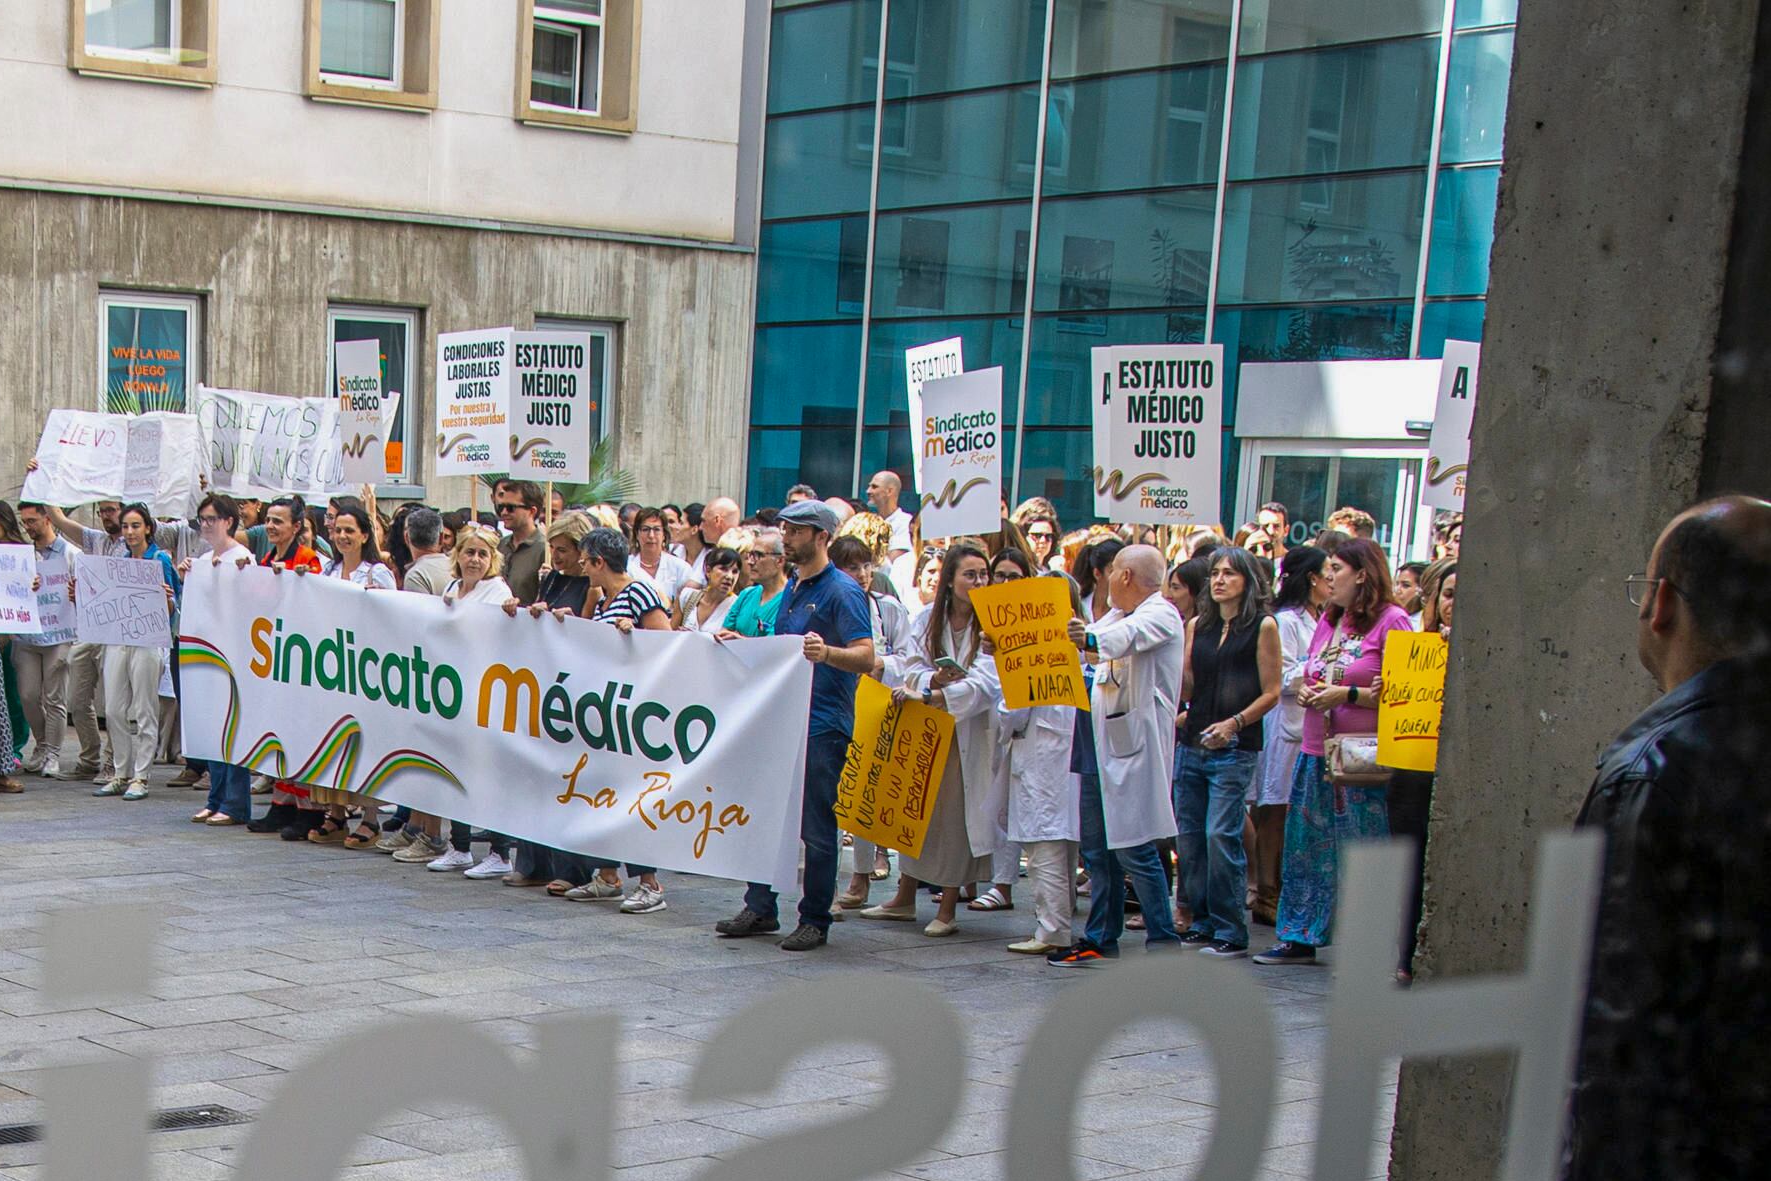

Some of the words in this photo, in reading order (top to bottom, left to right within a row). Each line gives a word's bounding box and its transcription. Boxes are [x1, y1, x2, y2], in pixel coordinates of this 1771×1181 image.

[112, 347, 136, 360] VIVE
[140, 348, 154, 360] LA
[155, 349, 180, 360] VIDA
[444, 340, 505, 362] CONDICIONES
[515, 344, 584, 369] ESTATUTO
[128, 365, 166, 378] LUEGO
[448, 360, 500, 381] LABORALES
[911, 352, 957, 384] ESTATUTO
[1118, 360, 1214, 388] ESTATUTO
[340, 375, 378, 392] Sindicato
[455, 381, 490, 400] JUSTAS
[521, 368, 577, 398] MÉDICO
[1450, 366, 1468, 400] A
[450, 404, 461, 415] Por
[463, 402, 490, 414] nuestra
[492, 402, 497, 414] y
[526, 402, 572, 427] JUSTO
[1127, 388, 1204, 424] MÉDICO
[198, 398, 317, 439] CUIDEMOS
[442, 416, 468, 428] vuestra
[470, 414, 506, 428] seguridad
[925, 410, 996, 435] Sindicato
[58, 423, 116, 448] LLEVO
[1134, 430, 1196, 458] JUSTO
[457, 443, 490, 453] Sindicato
[532, 449, 566, 459] Sindicato
[950, 453, 964, 467] La
[969, 452, 996, 468] Rioja
[276, 447, 312, 482] NOS
[1140, 486, 1188, 498] Sindicato
[22, 558, 28, 572] A
[988, 604, 1018, 628] LOS
[998, 630, 1038, 651] COTIZAN
[1044, 629, 1052, 642] LO
[250, 616, 464, 720] Sindicato
[1005, 656, 1022, 672] QUE
[1029, 652, 1044, 666] LAS
[1407, 640, 1446, 672] MINIS
[894, 729, 912, 770] ACTO
[834, 740, 864, 818] DEFENDER
[887, 774, 902, 800] UN
[556, 752, 617, 808] La
[628, 771, 751, 860] Rioja
[879, 806, 894, 826] ES
[897, 825, 915, 848] DE
